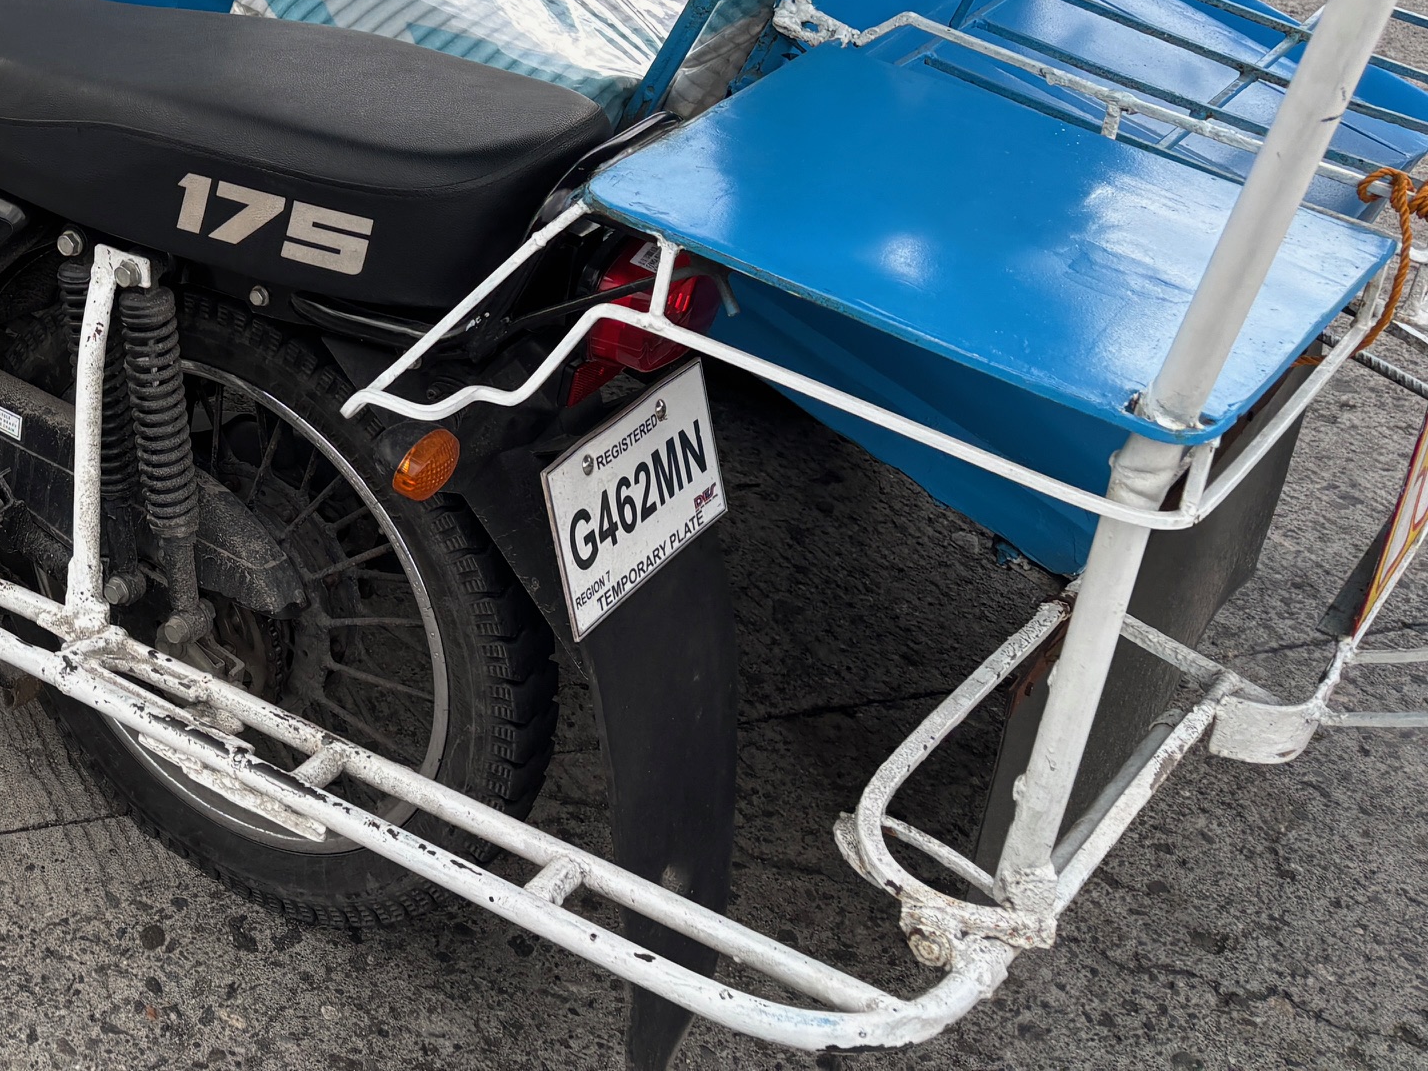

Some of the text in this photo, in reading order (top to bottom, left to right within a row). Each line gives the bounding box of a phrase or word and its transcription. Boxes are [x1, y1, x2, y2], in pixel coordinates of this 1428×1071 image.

[176, 172, 374, 275] 175
[596, 413, 658, 470] REGISTERED
[569, 419, 708, 571] G462MN
[575, 570, 612, 611] REGION 7
[597, 509, 705, 612] TEMPORARY PLATE
